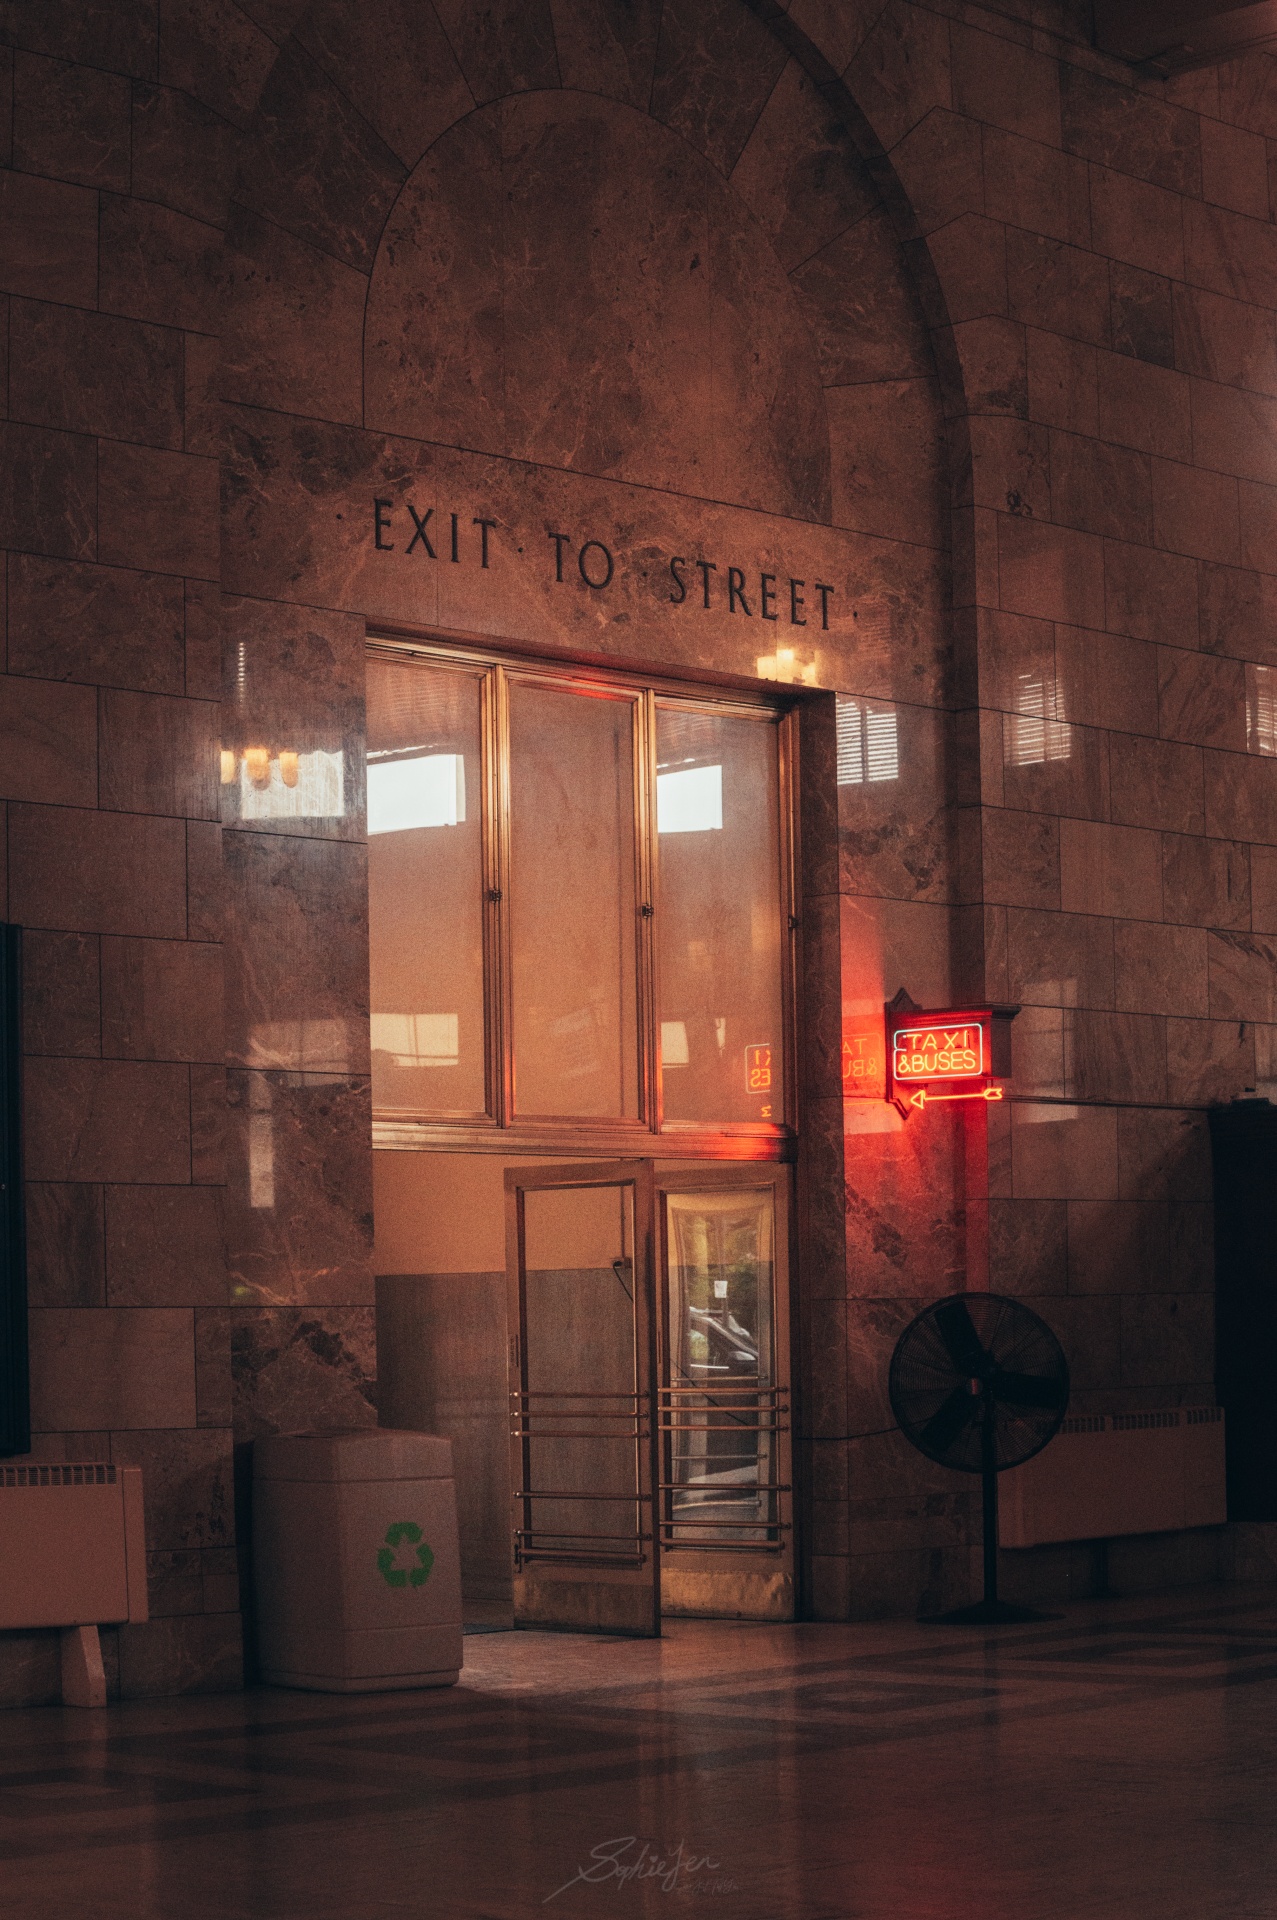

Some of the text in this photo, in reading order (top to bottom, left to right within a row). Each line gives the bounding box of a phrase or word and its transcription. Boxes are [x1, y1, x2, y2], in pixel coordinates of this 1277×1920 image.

[373, 498, 835, 631] EXIT TO STREET
[905, 1029, 969, 1051] TAXI
